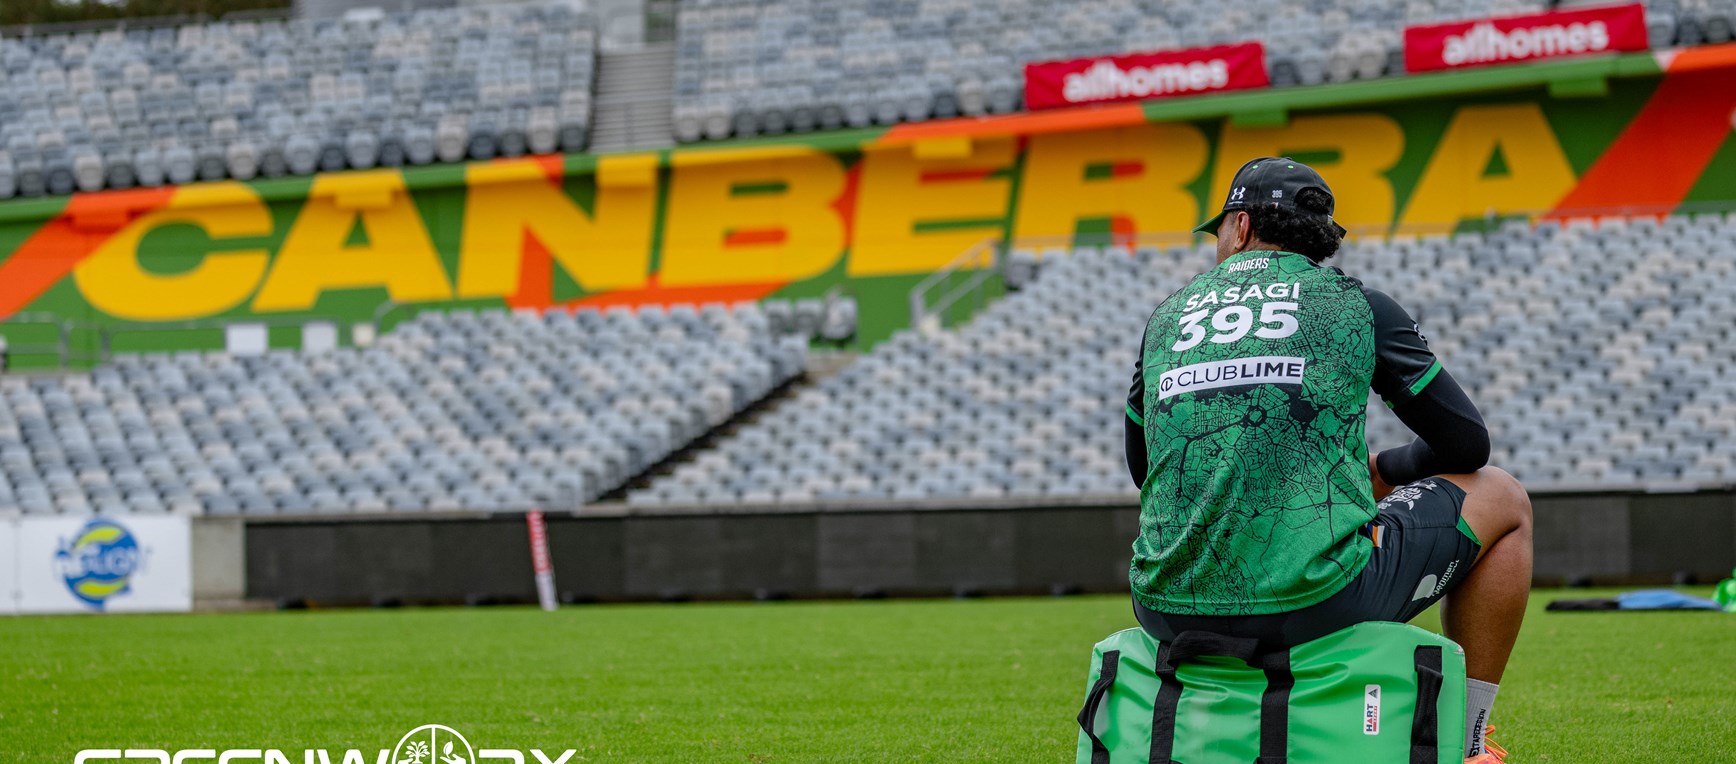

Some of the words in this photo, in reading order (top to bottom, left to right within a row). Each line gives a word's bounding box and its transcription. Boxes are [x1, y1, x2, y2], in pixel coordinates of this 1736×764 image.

[1442, 20, 1609, 65] allhomes
[1063, 58, 1229, 103] allhomes
[73, 104, 1578, 322] CANBERRA
[1228, 257, 1270, 274] RAIDERS
[1183, 282, 1300, 312] SASAGI
[1171, 301, 1299, 352] 395
